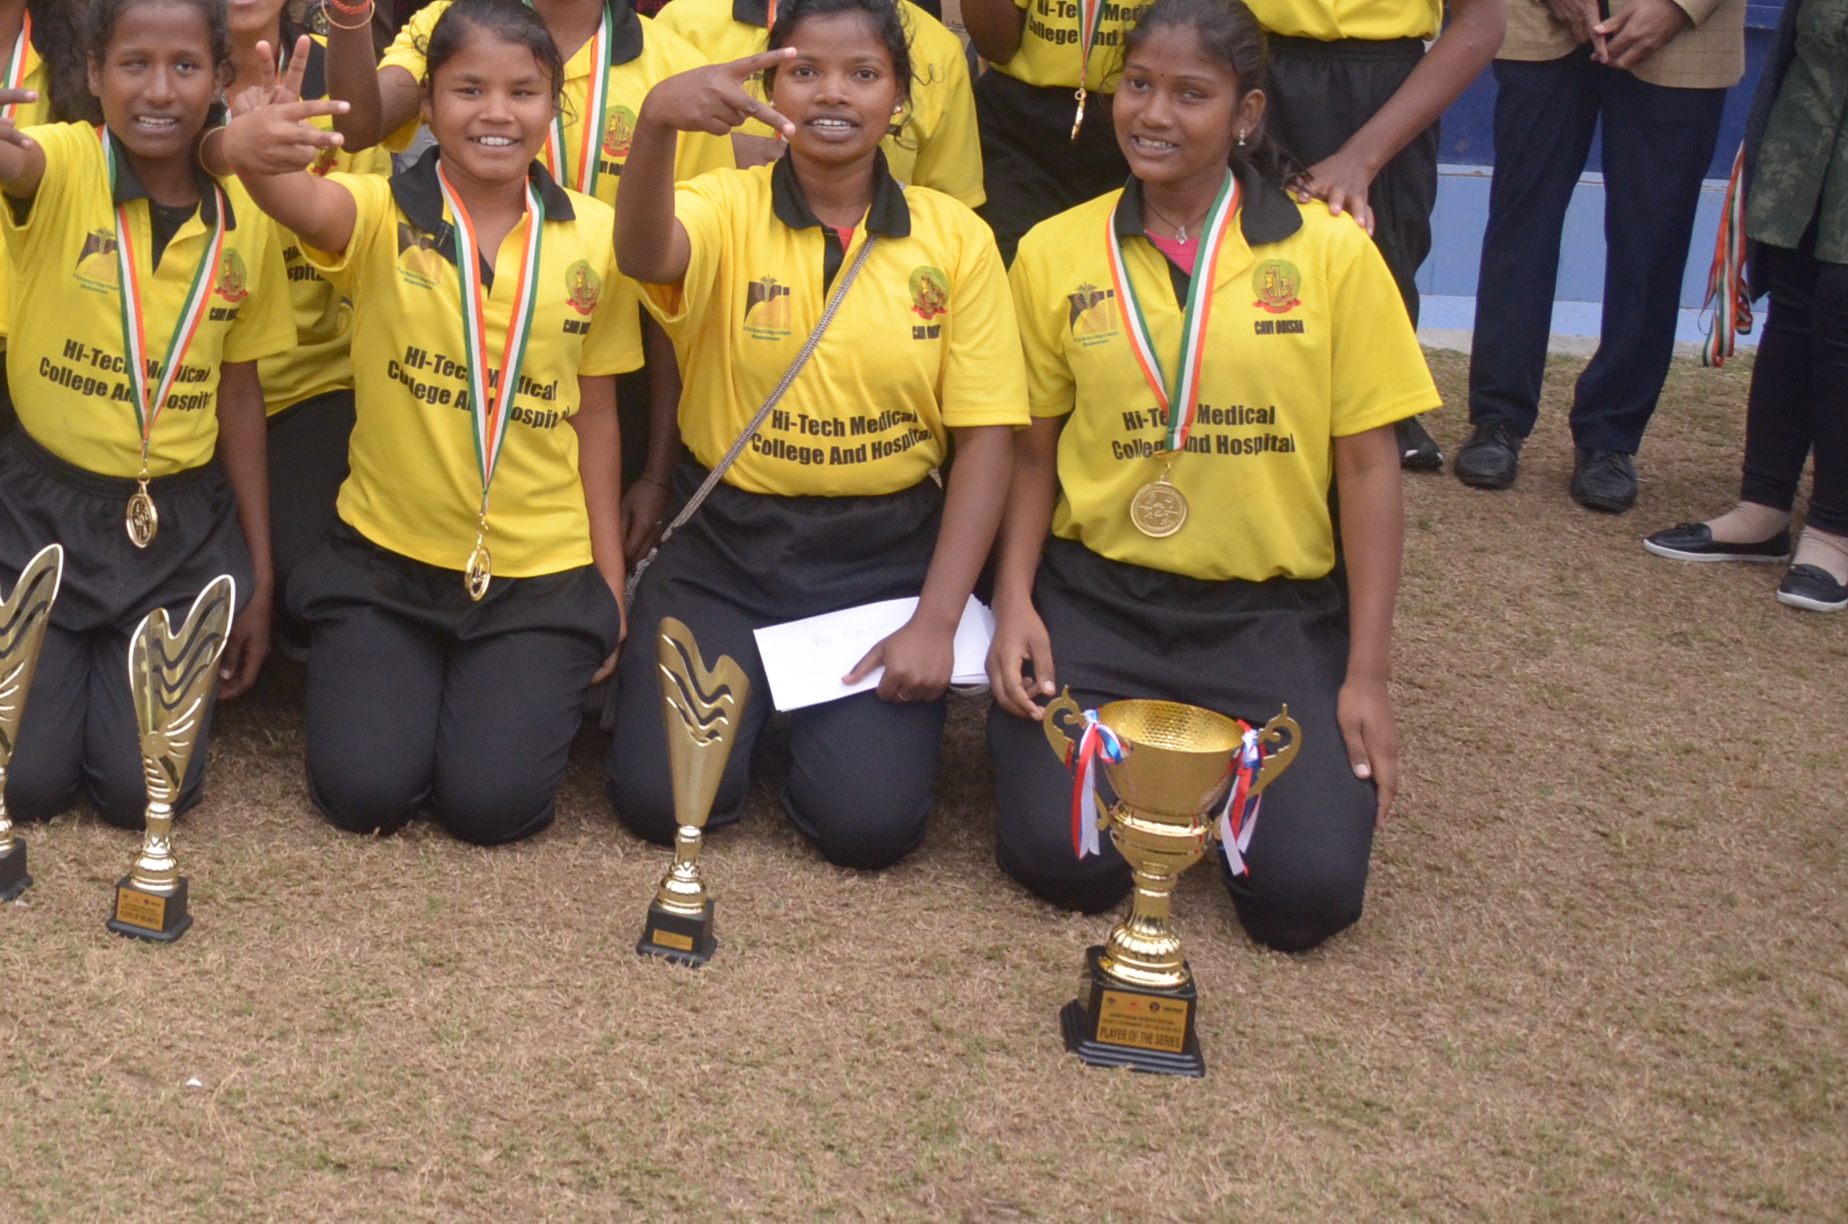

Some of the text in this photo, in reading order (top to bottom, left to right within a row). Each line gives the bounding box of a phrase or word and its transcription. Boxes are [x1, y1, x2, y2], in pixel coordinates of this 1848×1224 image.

[39, 356, 108, 398] College
[771, 409, 917, 437] Hi-Tech Medical
[1197, 404, 1276, 426] Medical
[752, 428, 932, 465] College And Hospital
[1216, 433, 1296, 456] Hospital
[1100, 1026, 1180, 1048] PLAYER OF THE SERIES
